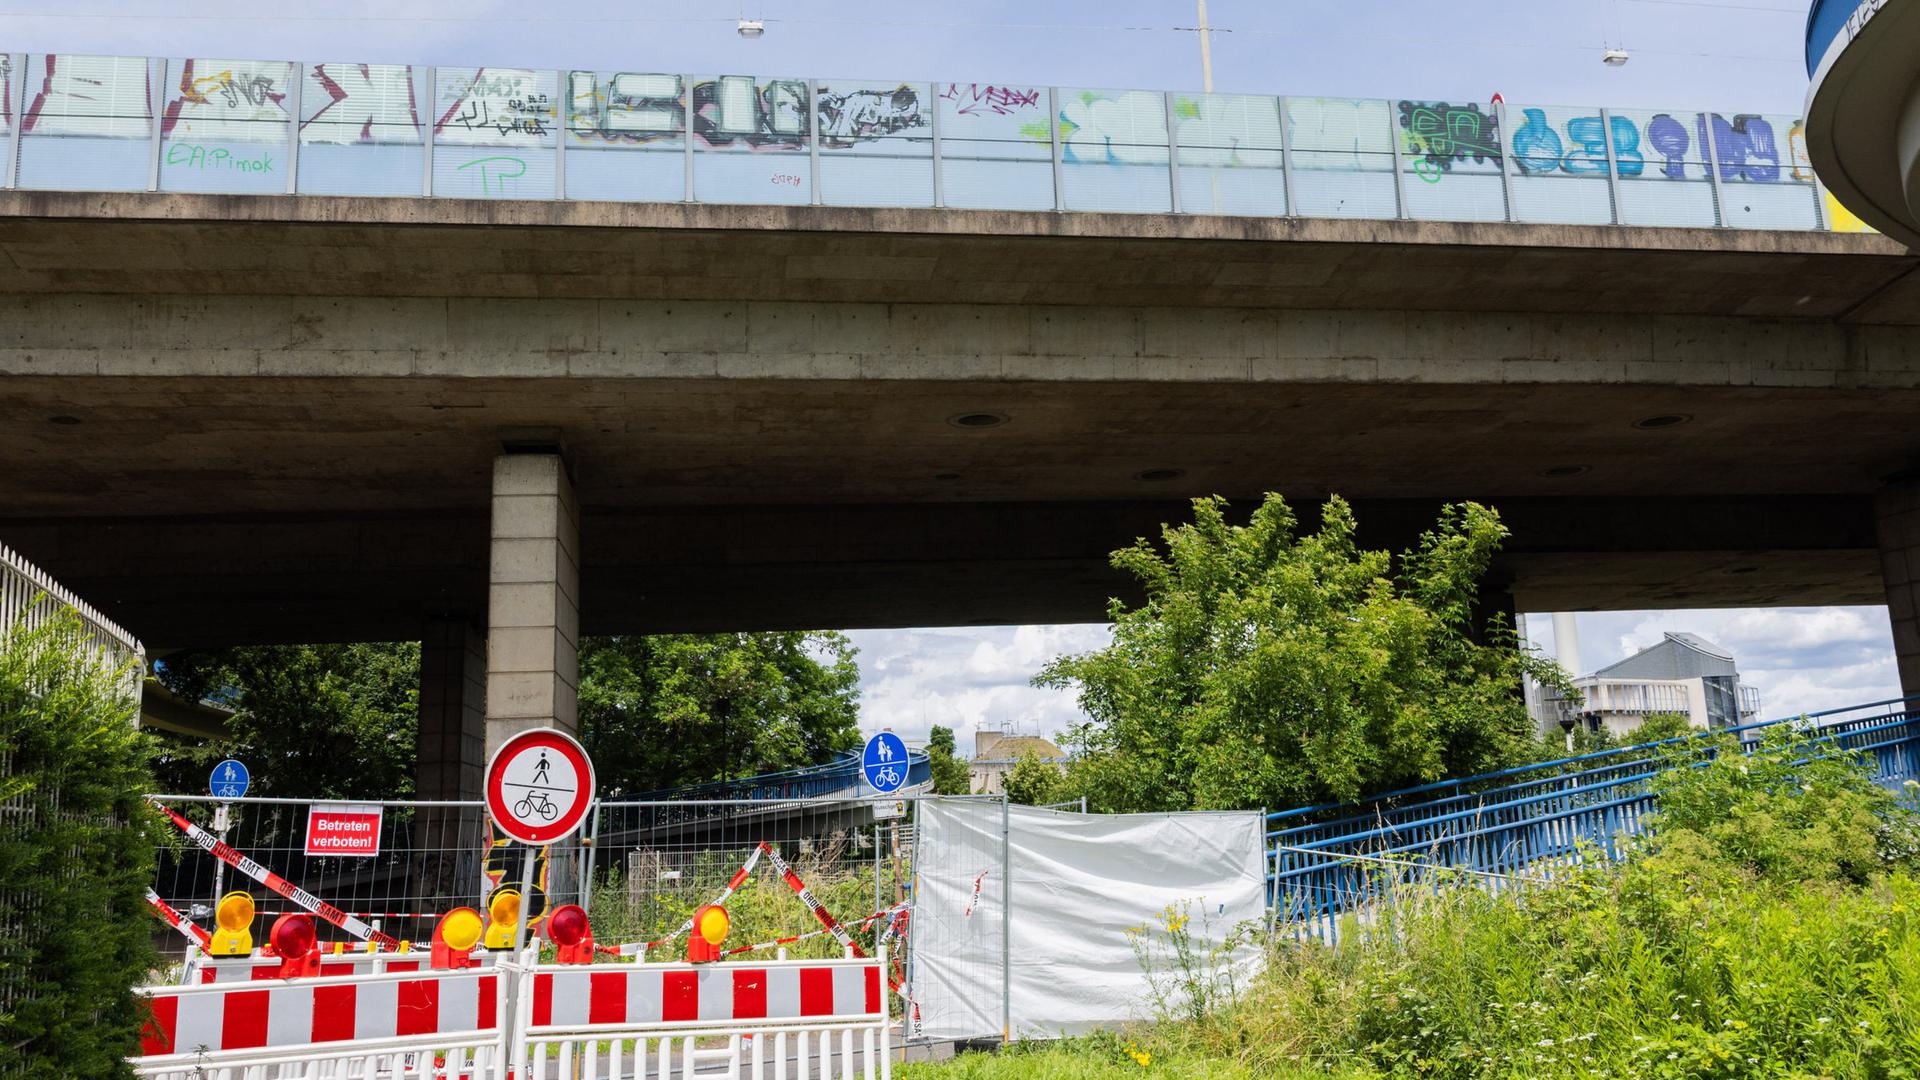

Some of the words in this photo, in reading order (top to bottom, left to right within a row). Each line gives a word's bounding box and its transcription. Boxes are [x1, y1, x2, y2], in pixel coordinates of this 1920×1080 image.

[318, 820, 371, 832] Betreten
[194, 830, 262, 877] ORDNUNGSAMT
[313, 836, 372, 848] verboten!
[279, 882, 346, 925] ORDNUNGSAMT
